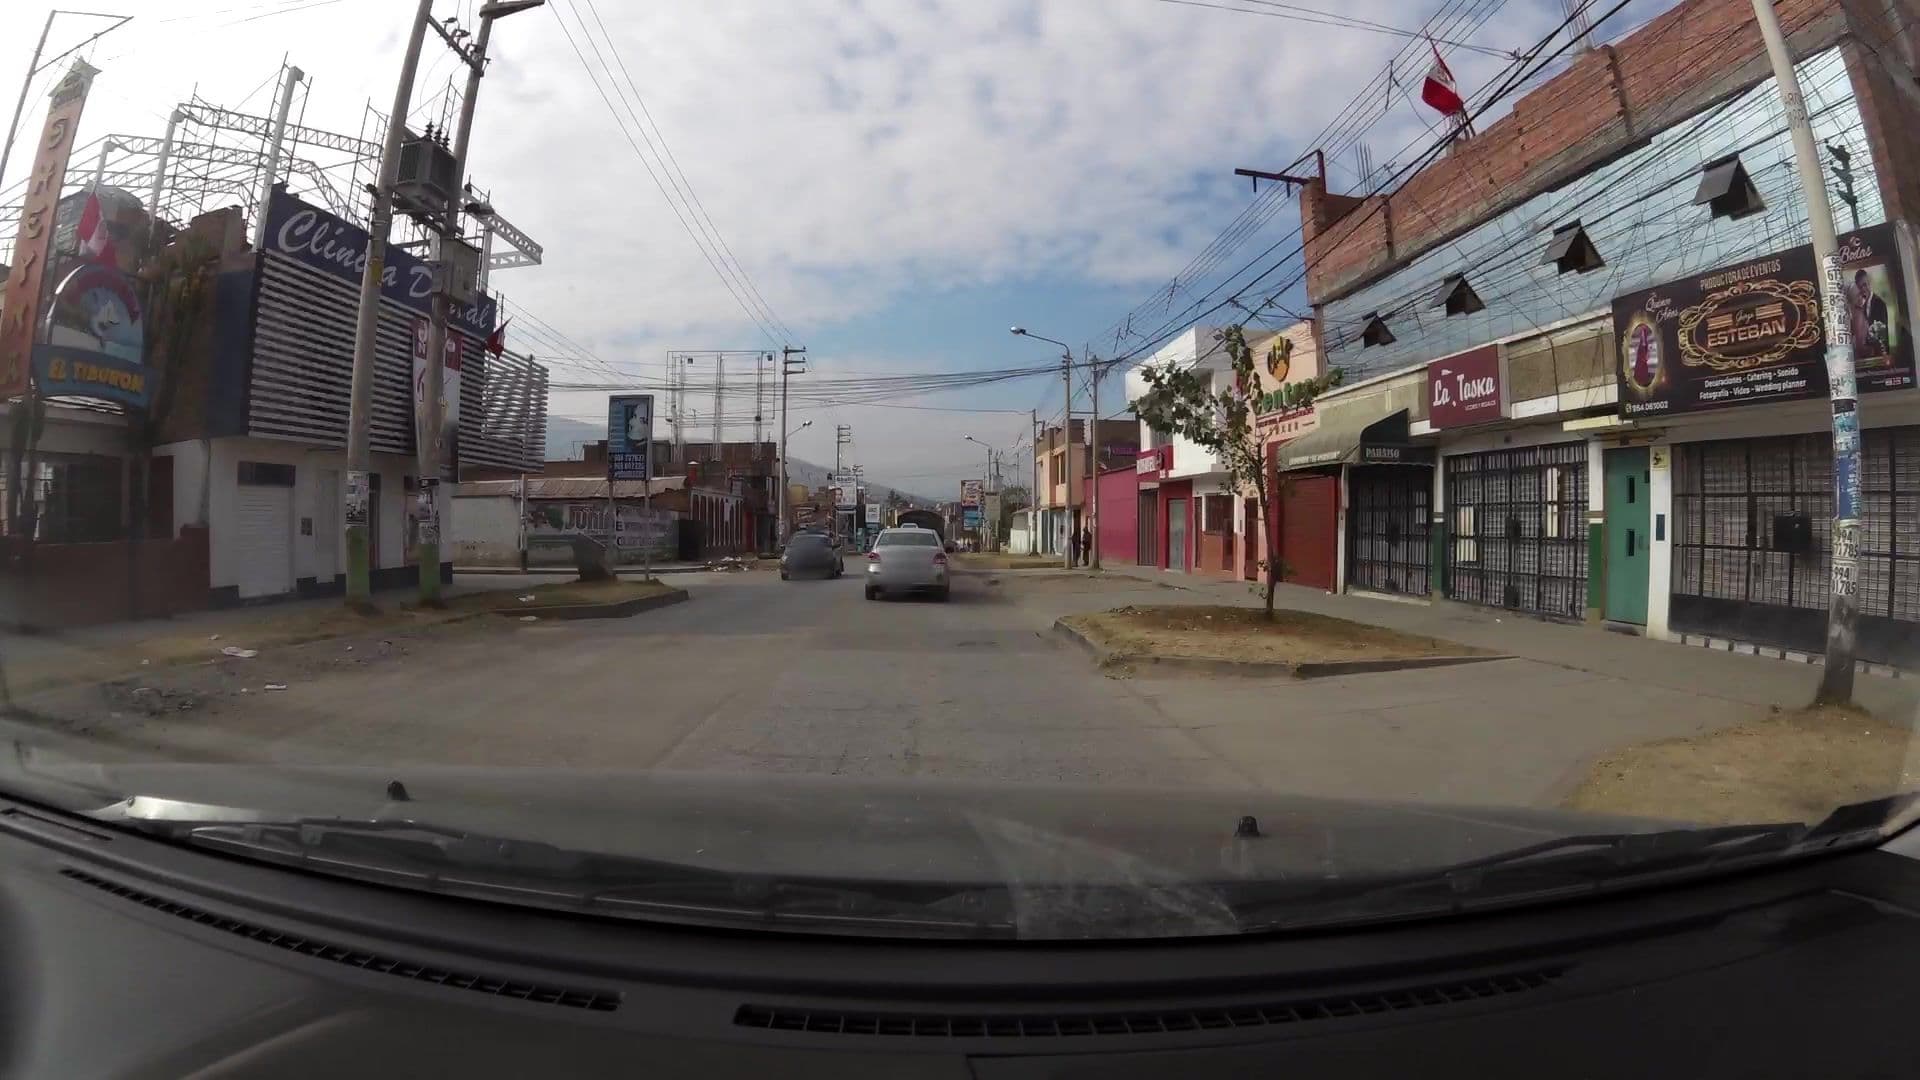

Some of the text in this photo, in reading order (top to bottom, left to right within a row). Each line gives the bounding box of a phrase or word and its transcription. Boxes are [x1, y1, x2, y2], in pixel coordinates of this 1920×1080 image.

[1699, 269, 1741, 291] PRODUCTORA
[1750, 259, 1781, 277] EVENTOS
[1707, 318, 1787, 348] ESTEBAN
[1704, 367, 1799, 388] Decoraciones Catering Sonido
[1754, 382, 1781, 392] Wedding
[1782, 379, 1807, 391] planner
[1432, 379, 1451, 407] La
